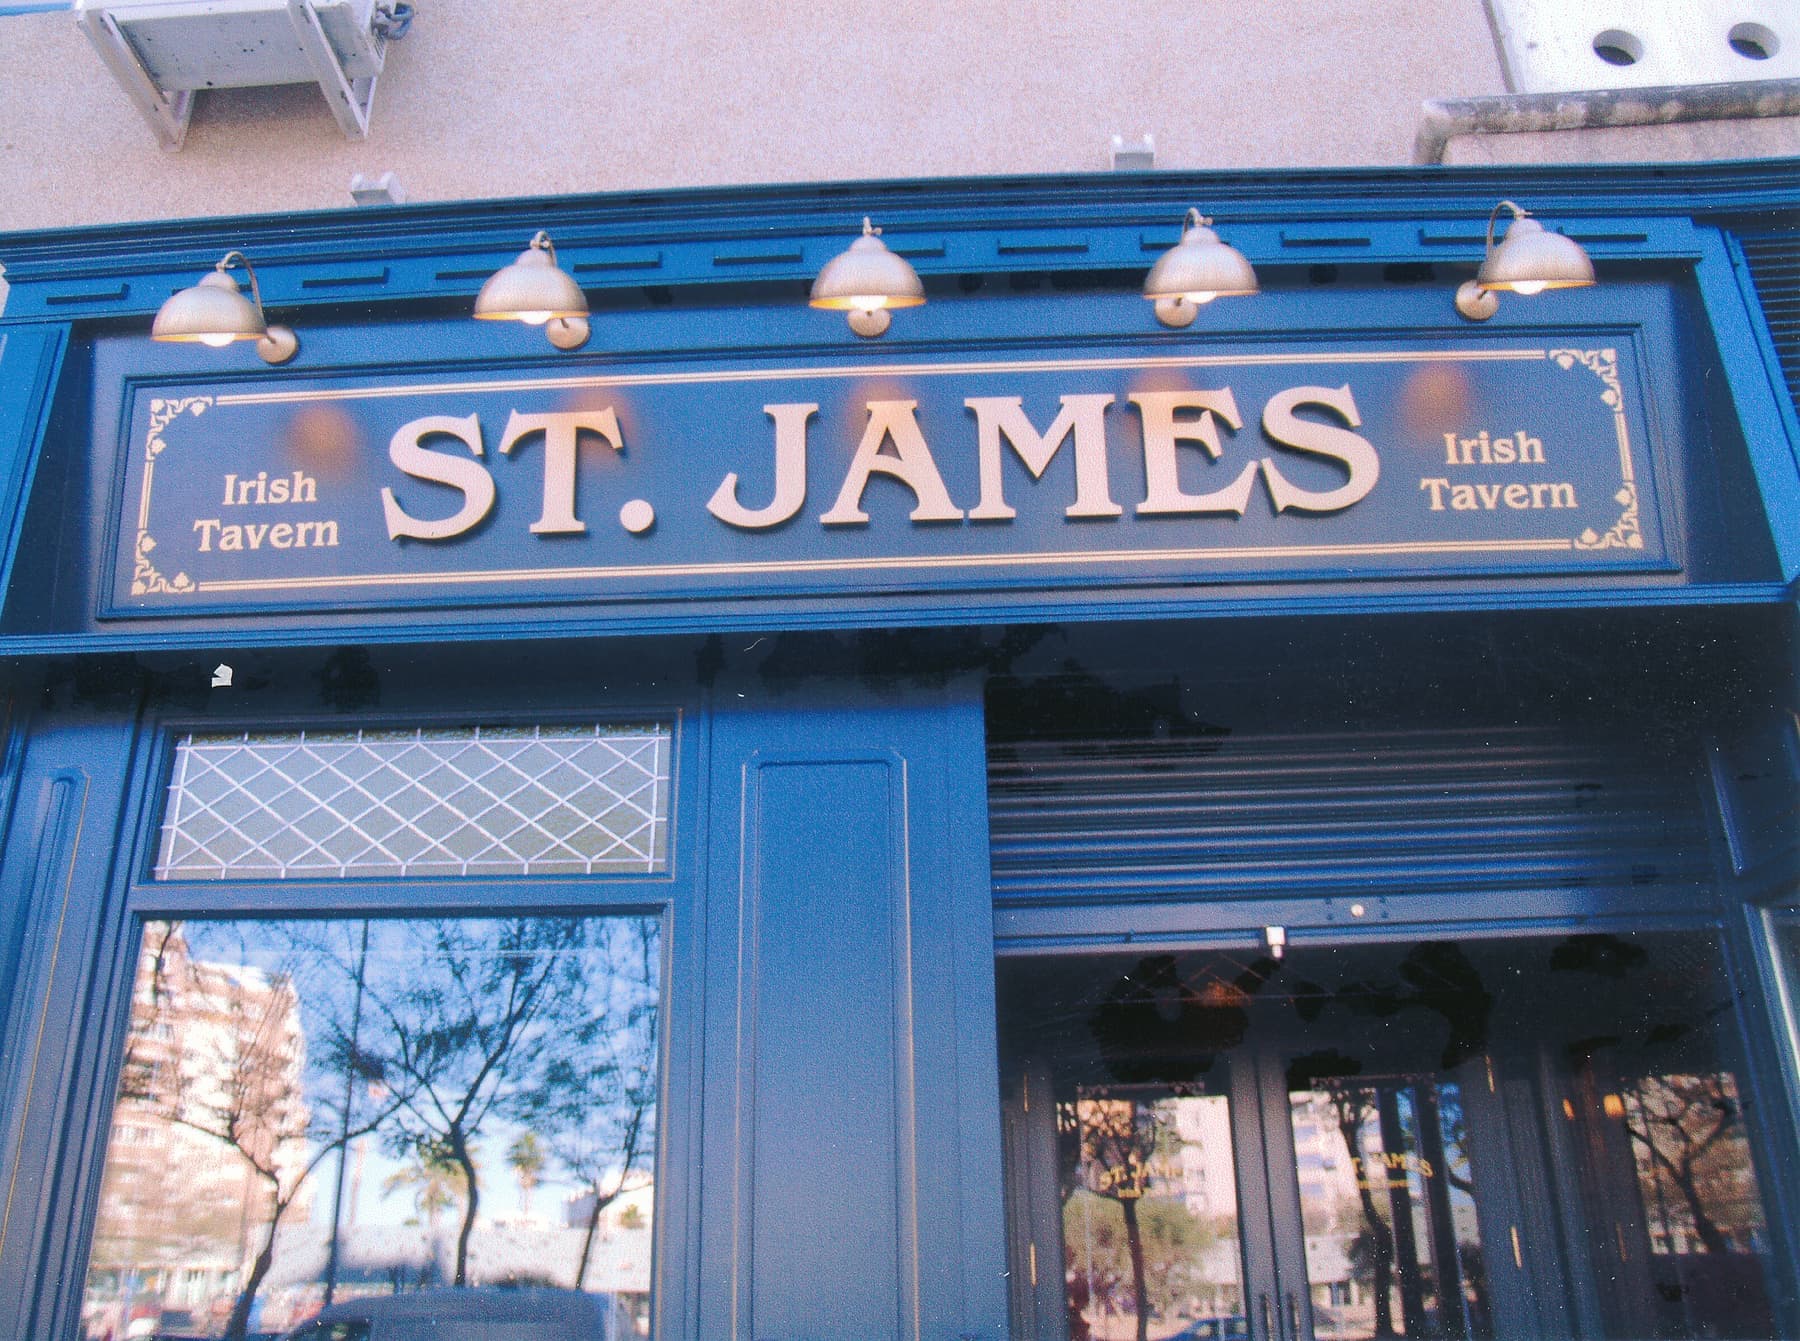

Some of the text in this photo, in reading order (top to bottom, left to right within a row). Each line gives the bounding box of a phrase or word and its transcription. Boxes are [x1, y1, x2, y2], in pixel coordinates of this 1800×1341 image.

[381, 384, 1380, 541] ST. JAMES
[1443, 430, 1546, 465] Irish
[222, 471, 317, 505] Irish
[1420, 477, 1578, 511] Tavern
[193, 518, 339, 552] Tavern
